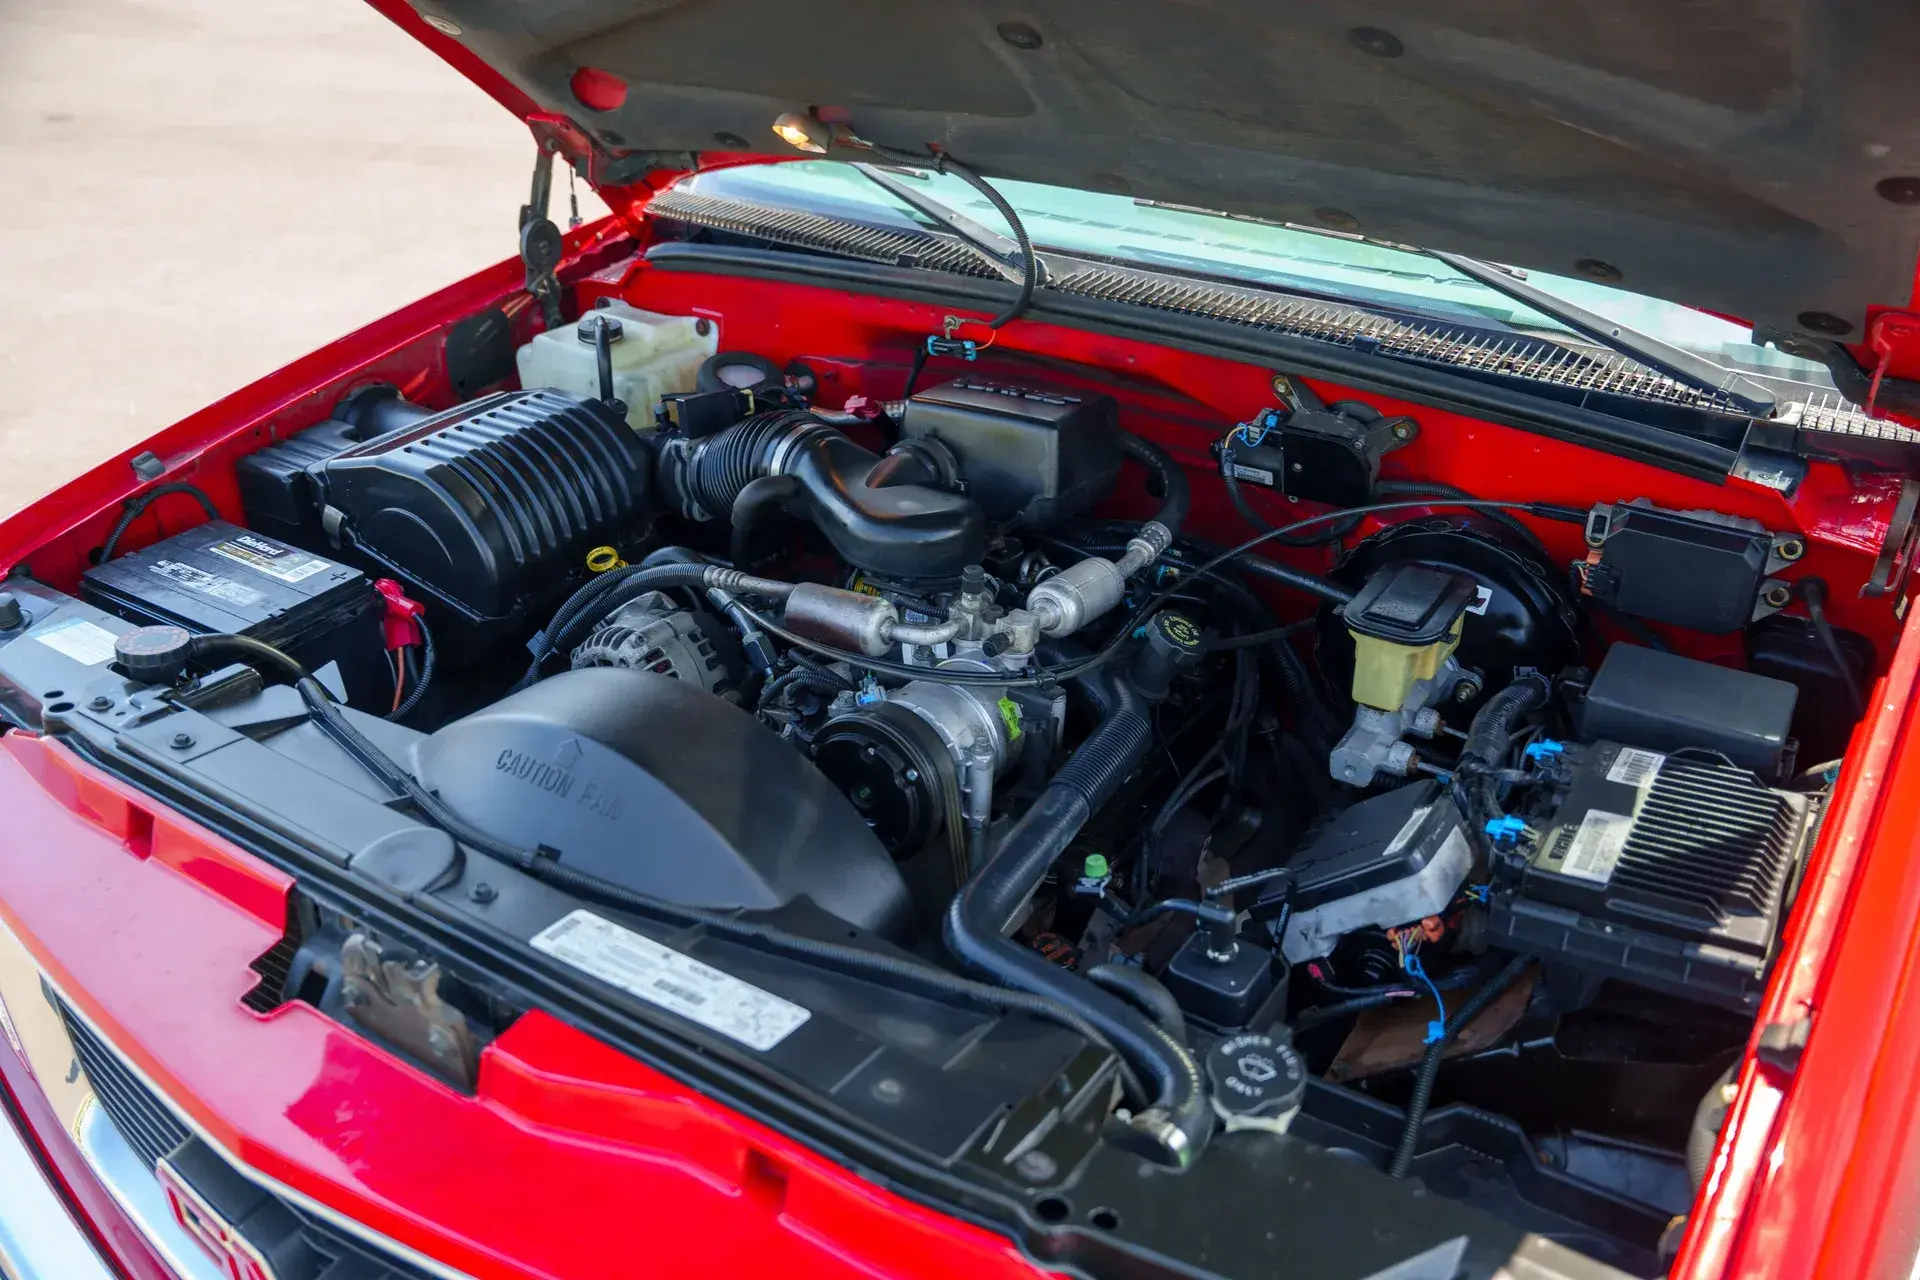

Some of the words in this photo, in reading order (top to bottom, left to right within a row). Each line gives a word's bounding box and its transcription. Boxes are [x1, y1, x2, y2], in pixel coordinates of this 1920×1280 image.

[236, 535, 284, 556] DieHard
[496, 748, 576, 798] CAUTION
[577, 780, 623, 820] FAN
